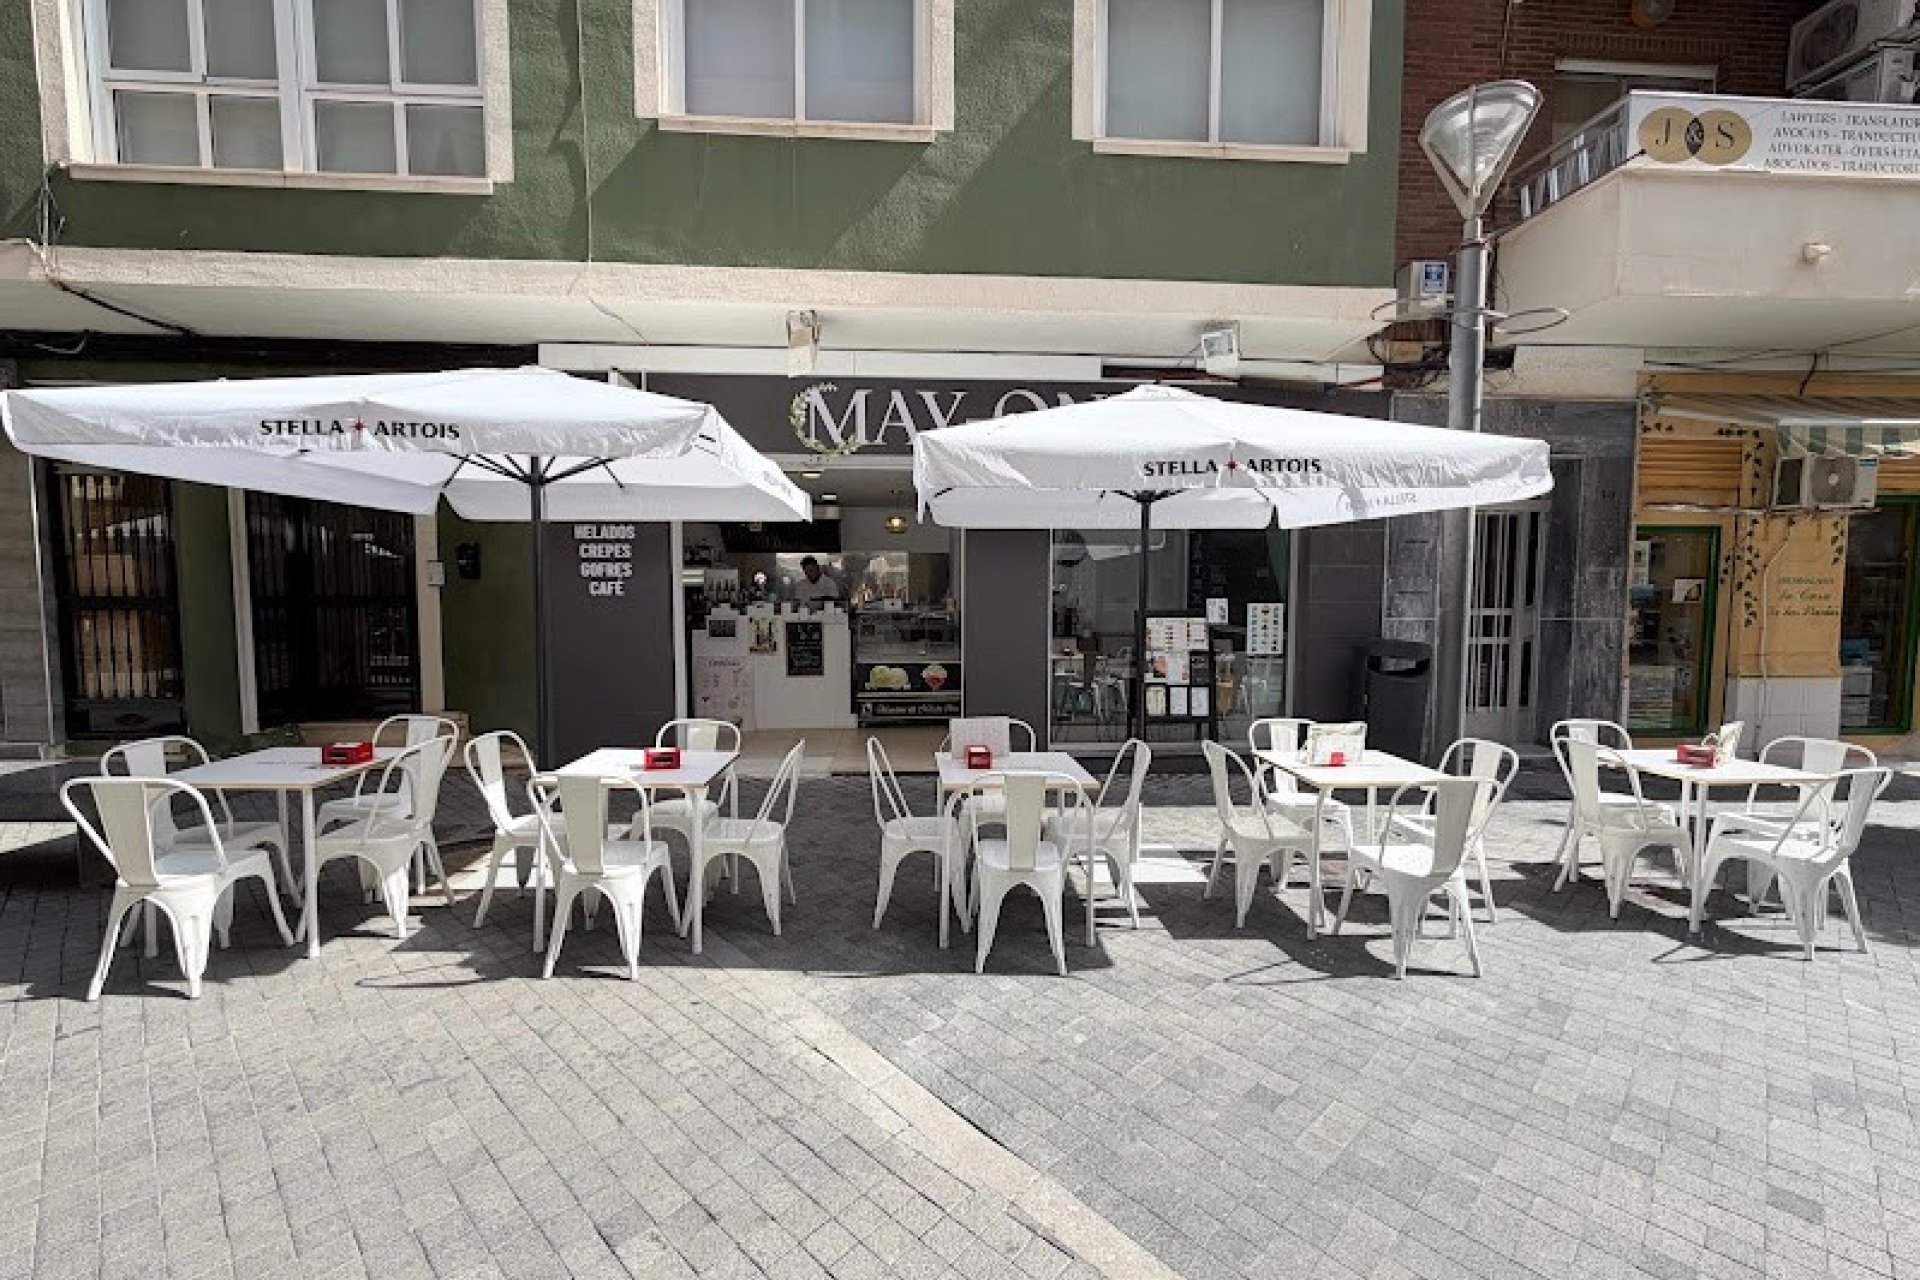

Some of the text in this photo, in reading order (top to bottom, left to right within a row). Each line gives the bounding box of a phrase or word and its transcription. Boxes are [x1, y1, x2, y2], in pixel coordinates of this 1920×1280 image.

[1773, 127, 1830, 140] AVOCATS
[260, 419, 460, 440] STELLA ARTOIS
[1143, 457, 1322, 477] STELLA ARTOIS
[573, 523, 636, 539] HELADOS
[578, 542, 633, 559] CREPES
[580, 562, 633, 578] GOFRES
